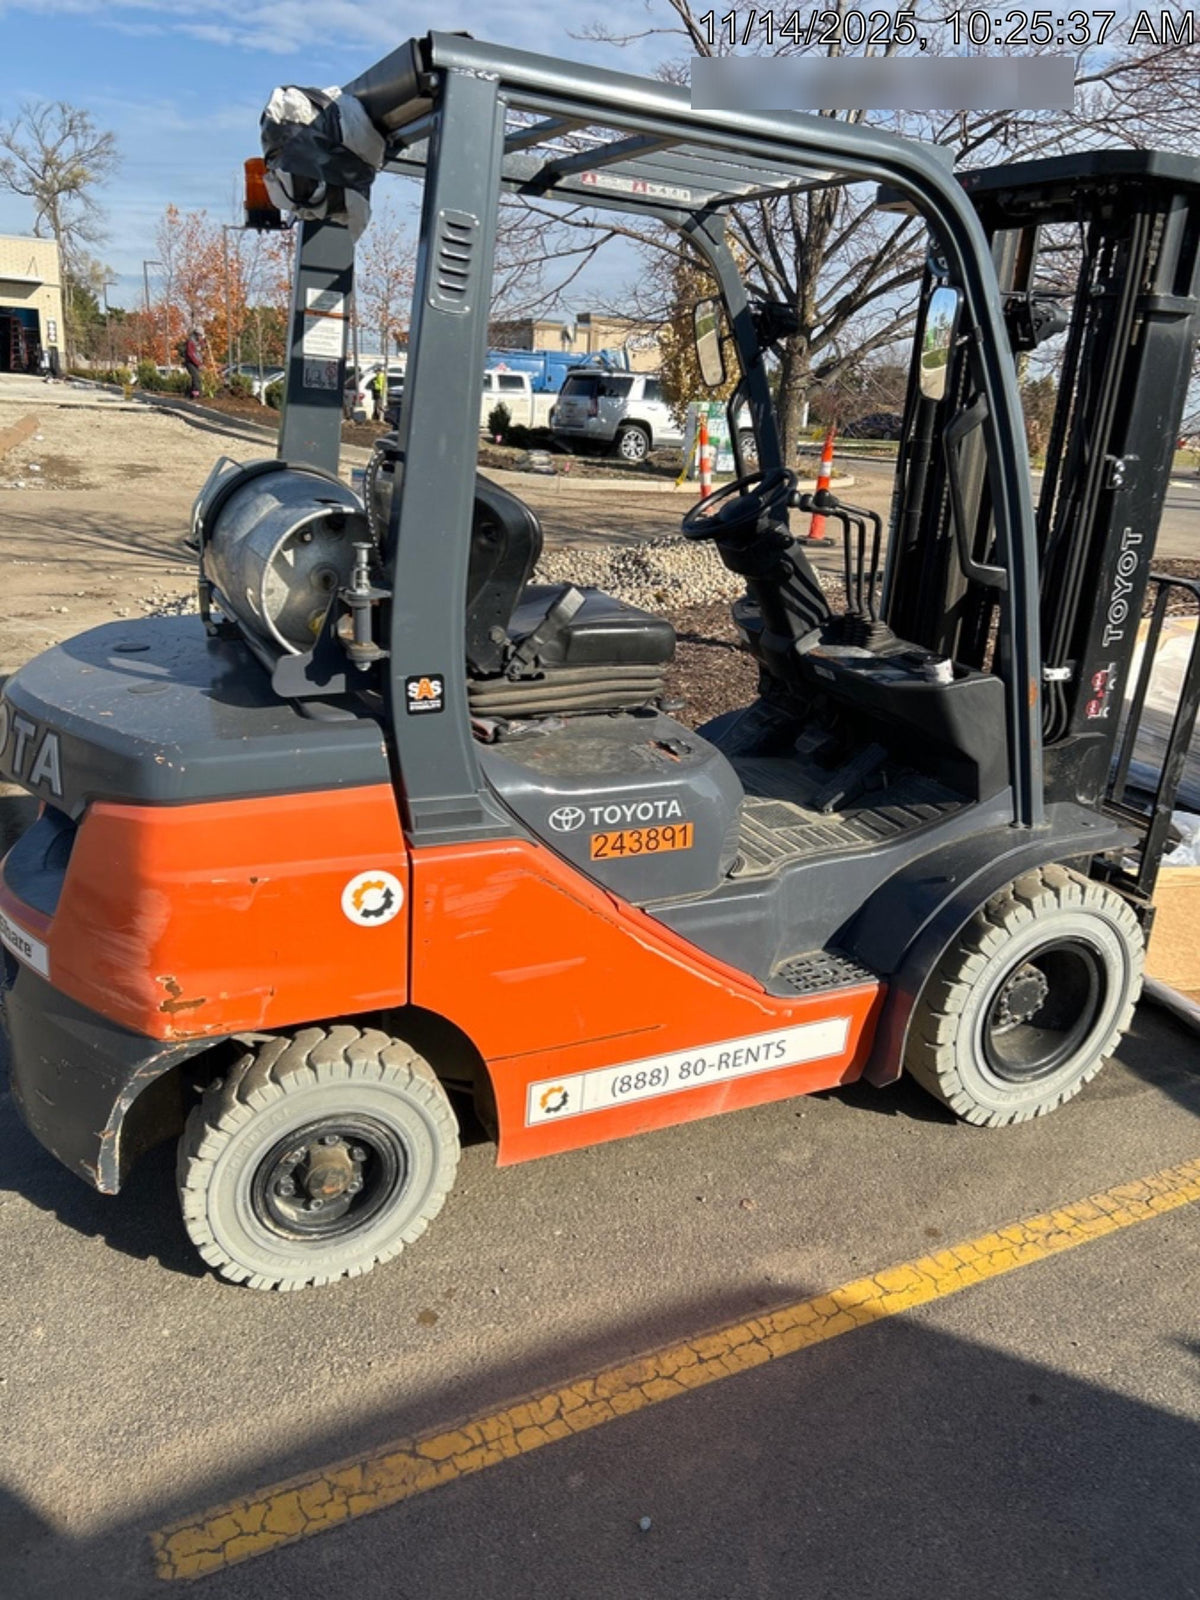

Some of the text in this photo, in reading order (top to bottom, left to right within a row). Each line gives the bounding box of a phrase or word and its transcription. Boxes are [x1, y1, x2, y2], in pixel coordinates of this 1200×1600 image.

[408, 677, 442, 700] SAS
[589, 799, 682, 826] TOYOTA
[593, 824, 691, 859] 243891
[611, 1039, 787, 1098] (888) 80-RENTS
